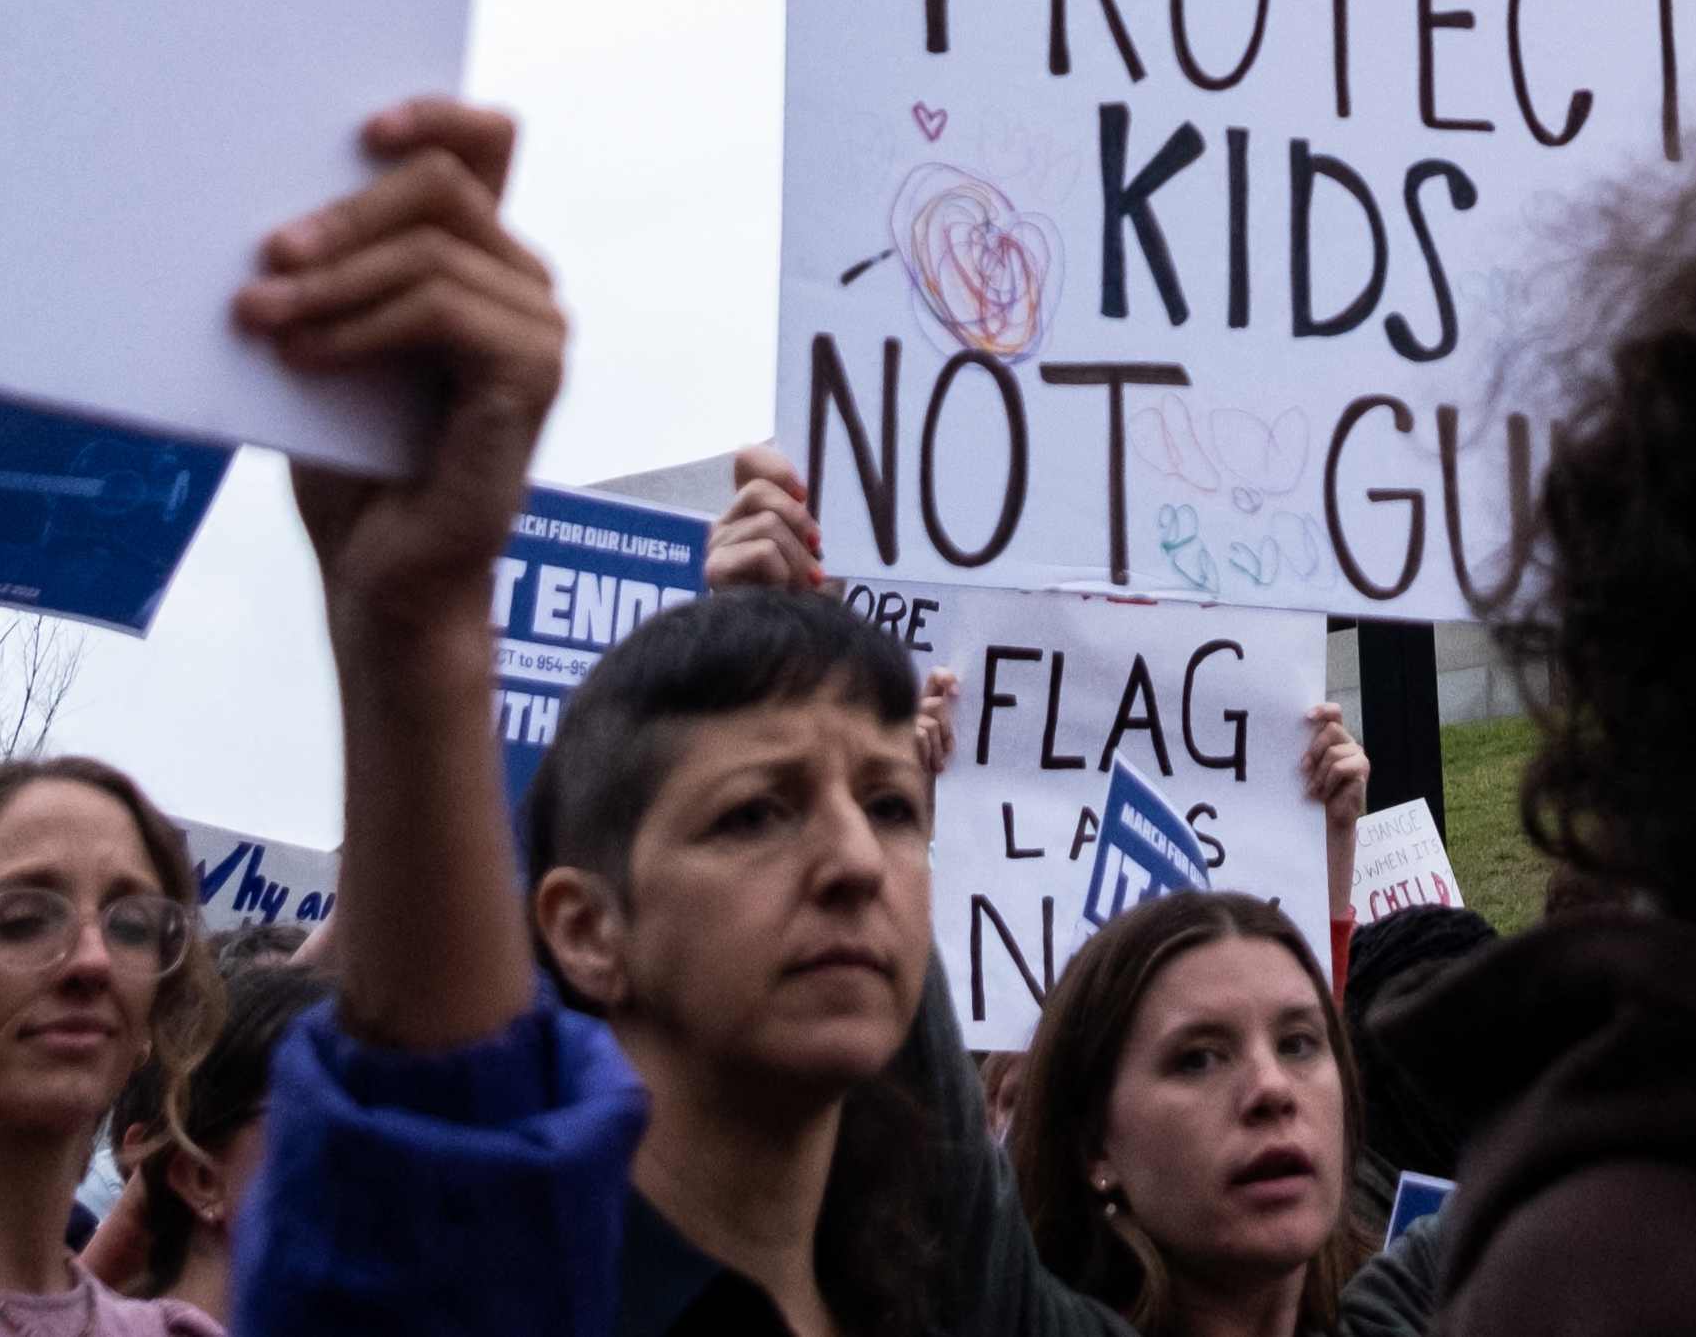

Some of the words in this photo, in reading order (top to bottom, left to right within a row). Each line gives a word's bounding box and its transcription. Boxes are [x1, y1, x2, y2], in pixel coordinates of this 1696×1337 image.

[1098, 101, 1479, 363] KIDS
[807, 331, 1191, 586] NOT
[1324, 393, 1565, 619] GU
[549, 519, 583, 544] FOR
[584, 526, 619, 551] OUR
[621, 534, 668, 560] LIVES
[520, 654, 533, 667] to
[537, 655, 594, 676] 954-95
[975, 638, 1250, 783] FLAG
[1001, 800, 1227, 869] LAS
